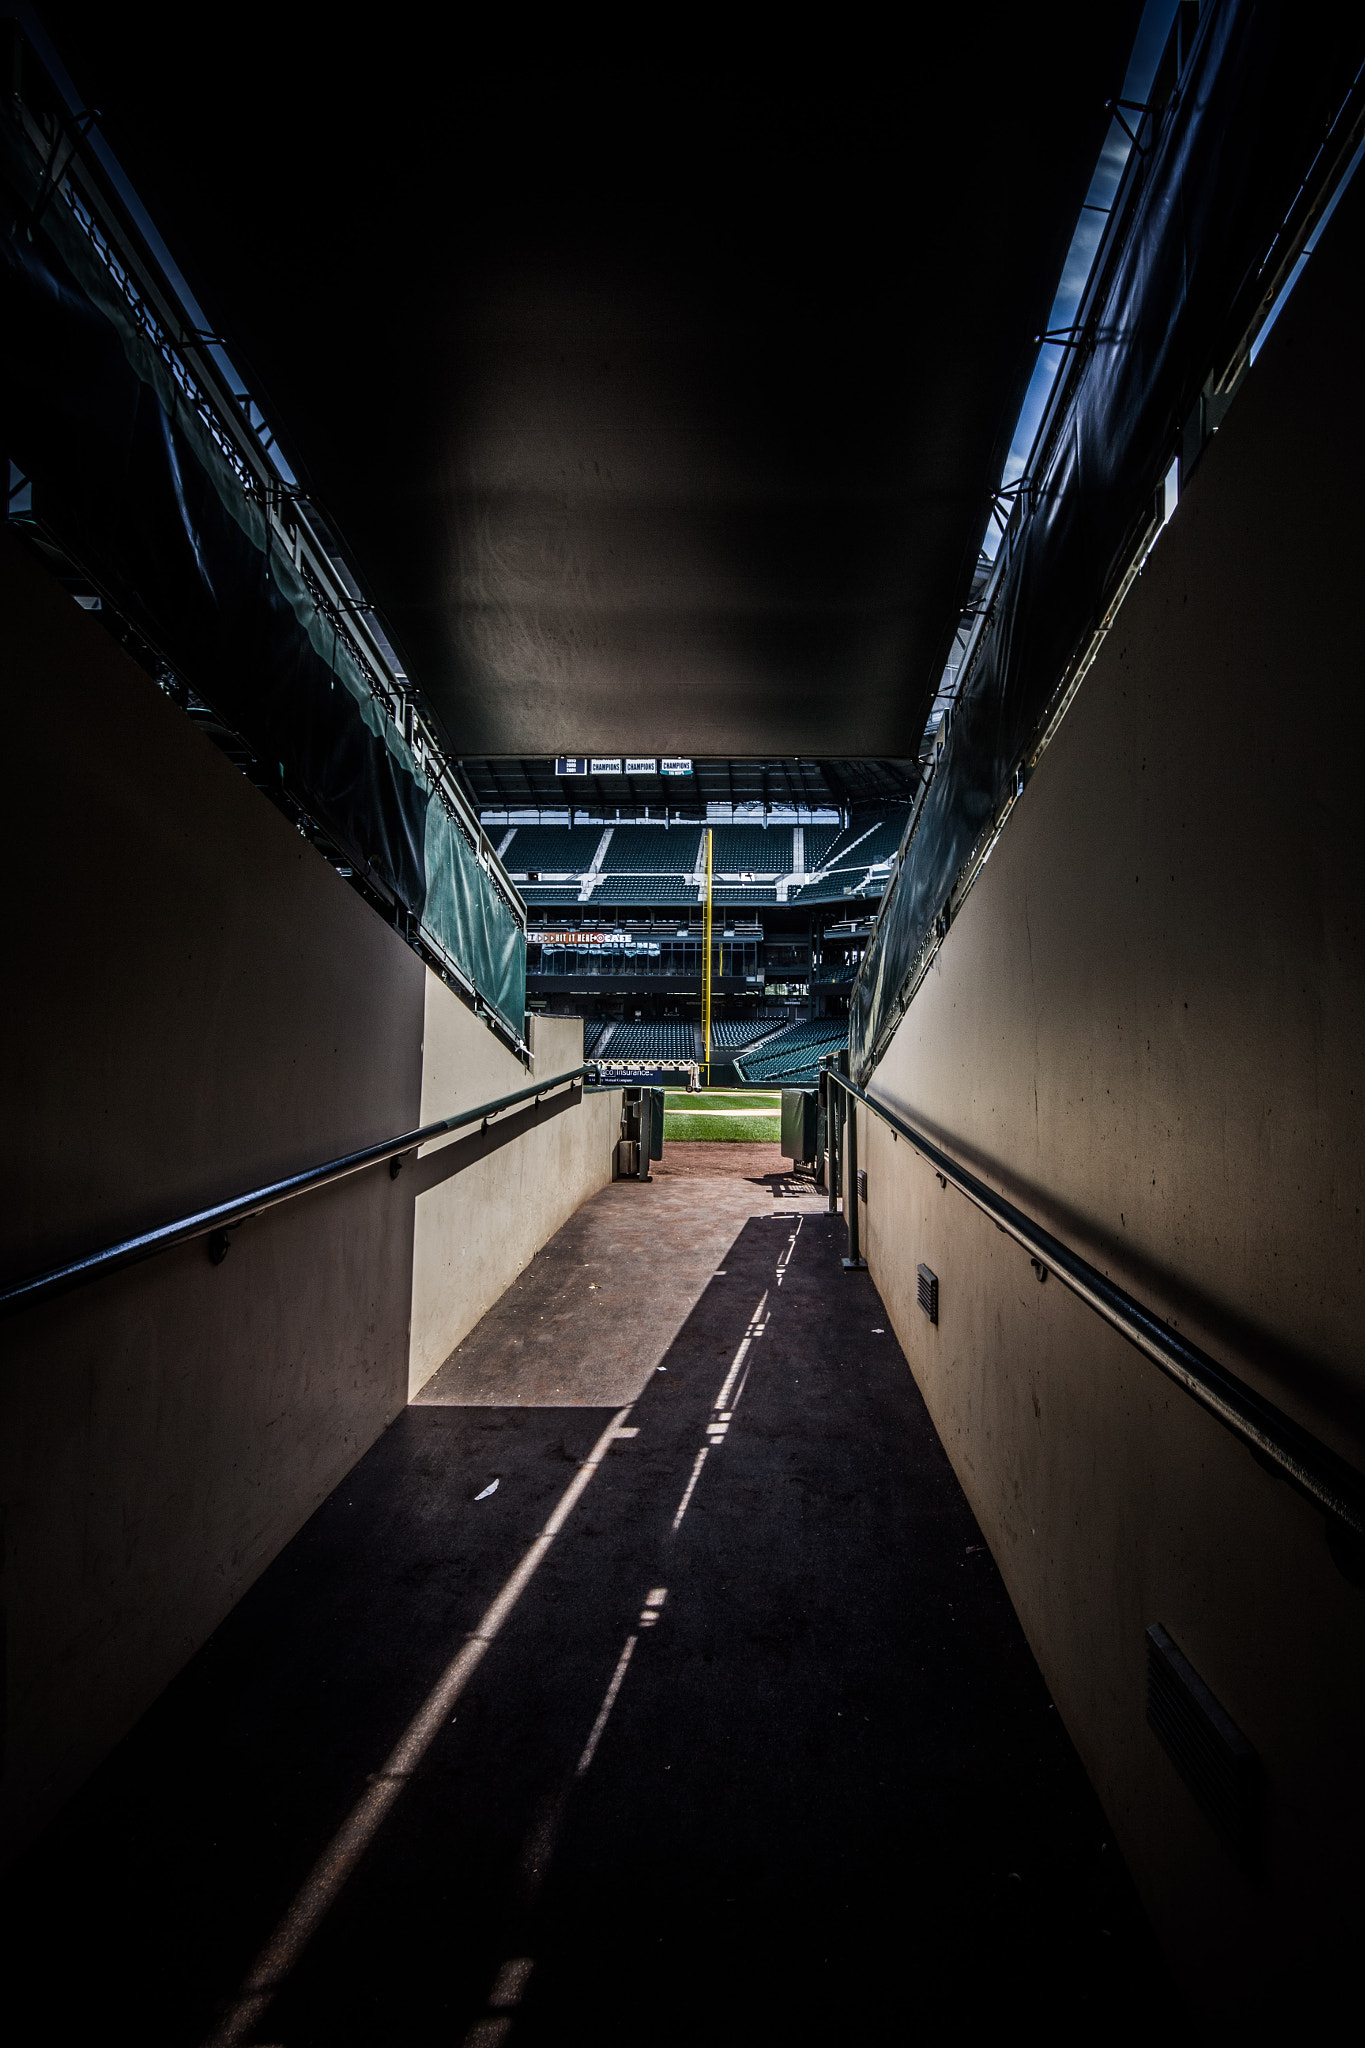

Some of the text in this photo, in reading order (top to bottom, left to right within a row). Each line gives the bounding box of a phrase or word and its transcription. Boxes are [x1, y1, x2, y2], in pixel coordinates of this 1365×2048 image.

[592, 763, 620, 771] CHAMPIONS
[627, 763, 655, 771] CHAMPIONS
[663, 762, 690, 770] CHAMPIONS
[555, 933, 632, 943] HIT IT HERE CAFE
